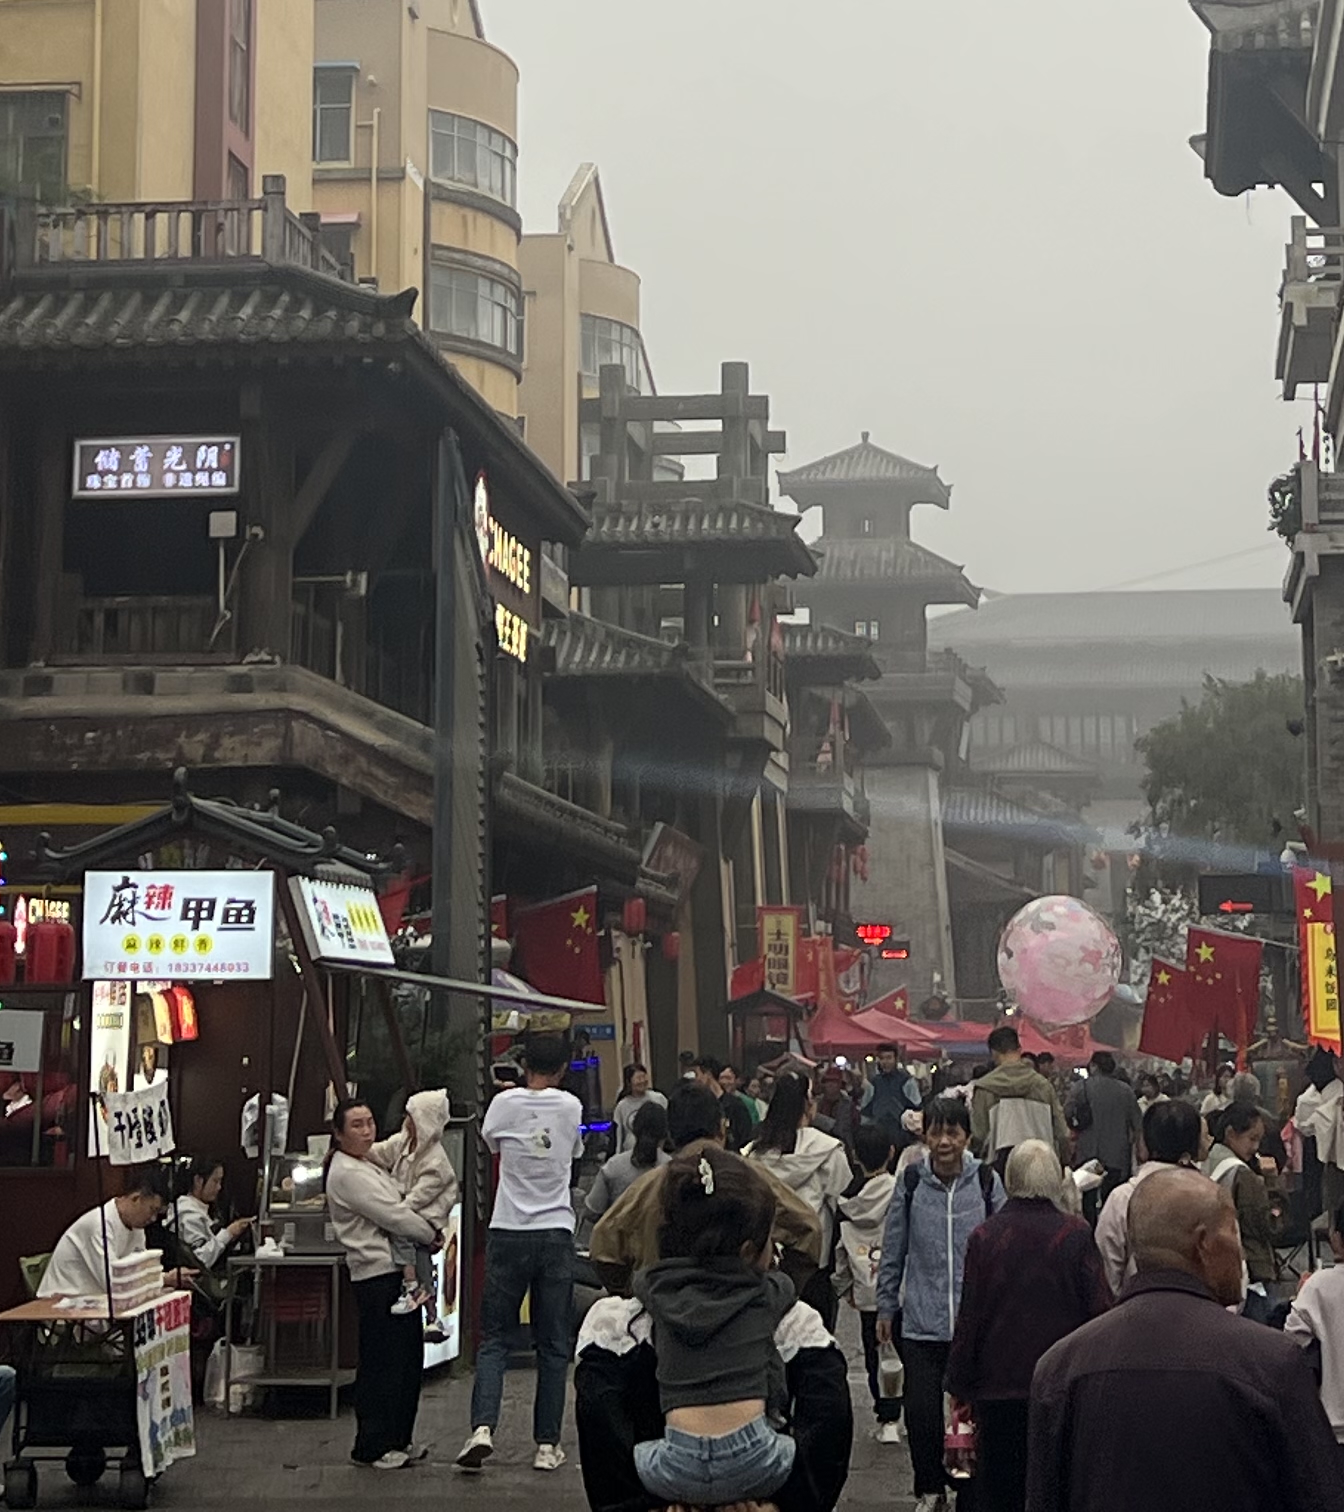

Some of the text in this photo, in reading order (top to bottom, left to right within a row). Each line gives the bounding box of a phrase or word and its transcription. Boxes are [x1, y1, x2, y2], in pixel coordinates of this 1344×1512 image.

[94, 444, 219, 473] 储蓄光阴
[100, 875, 258, 932] 麻辣甲鱼
